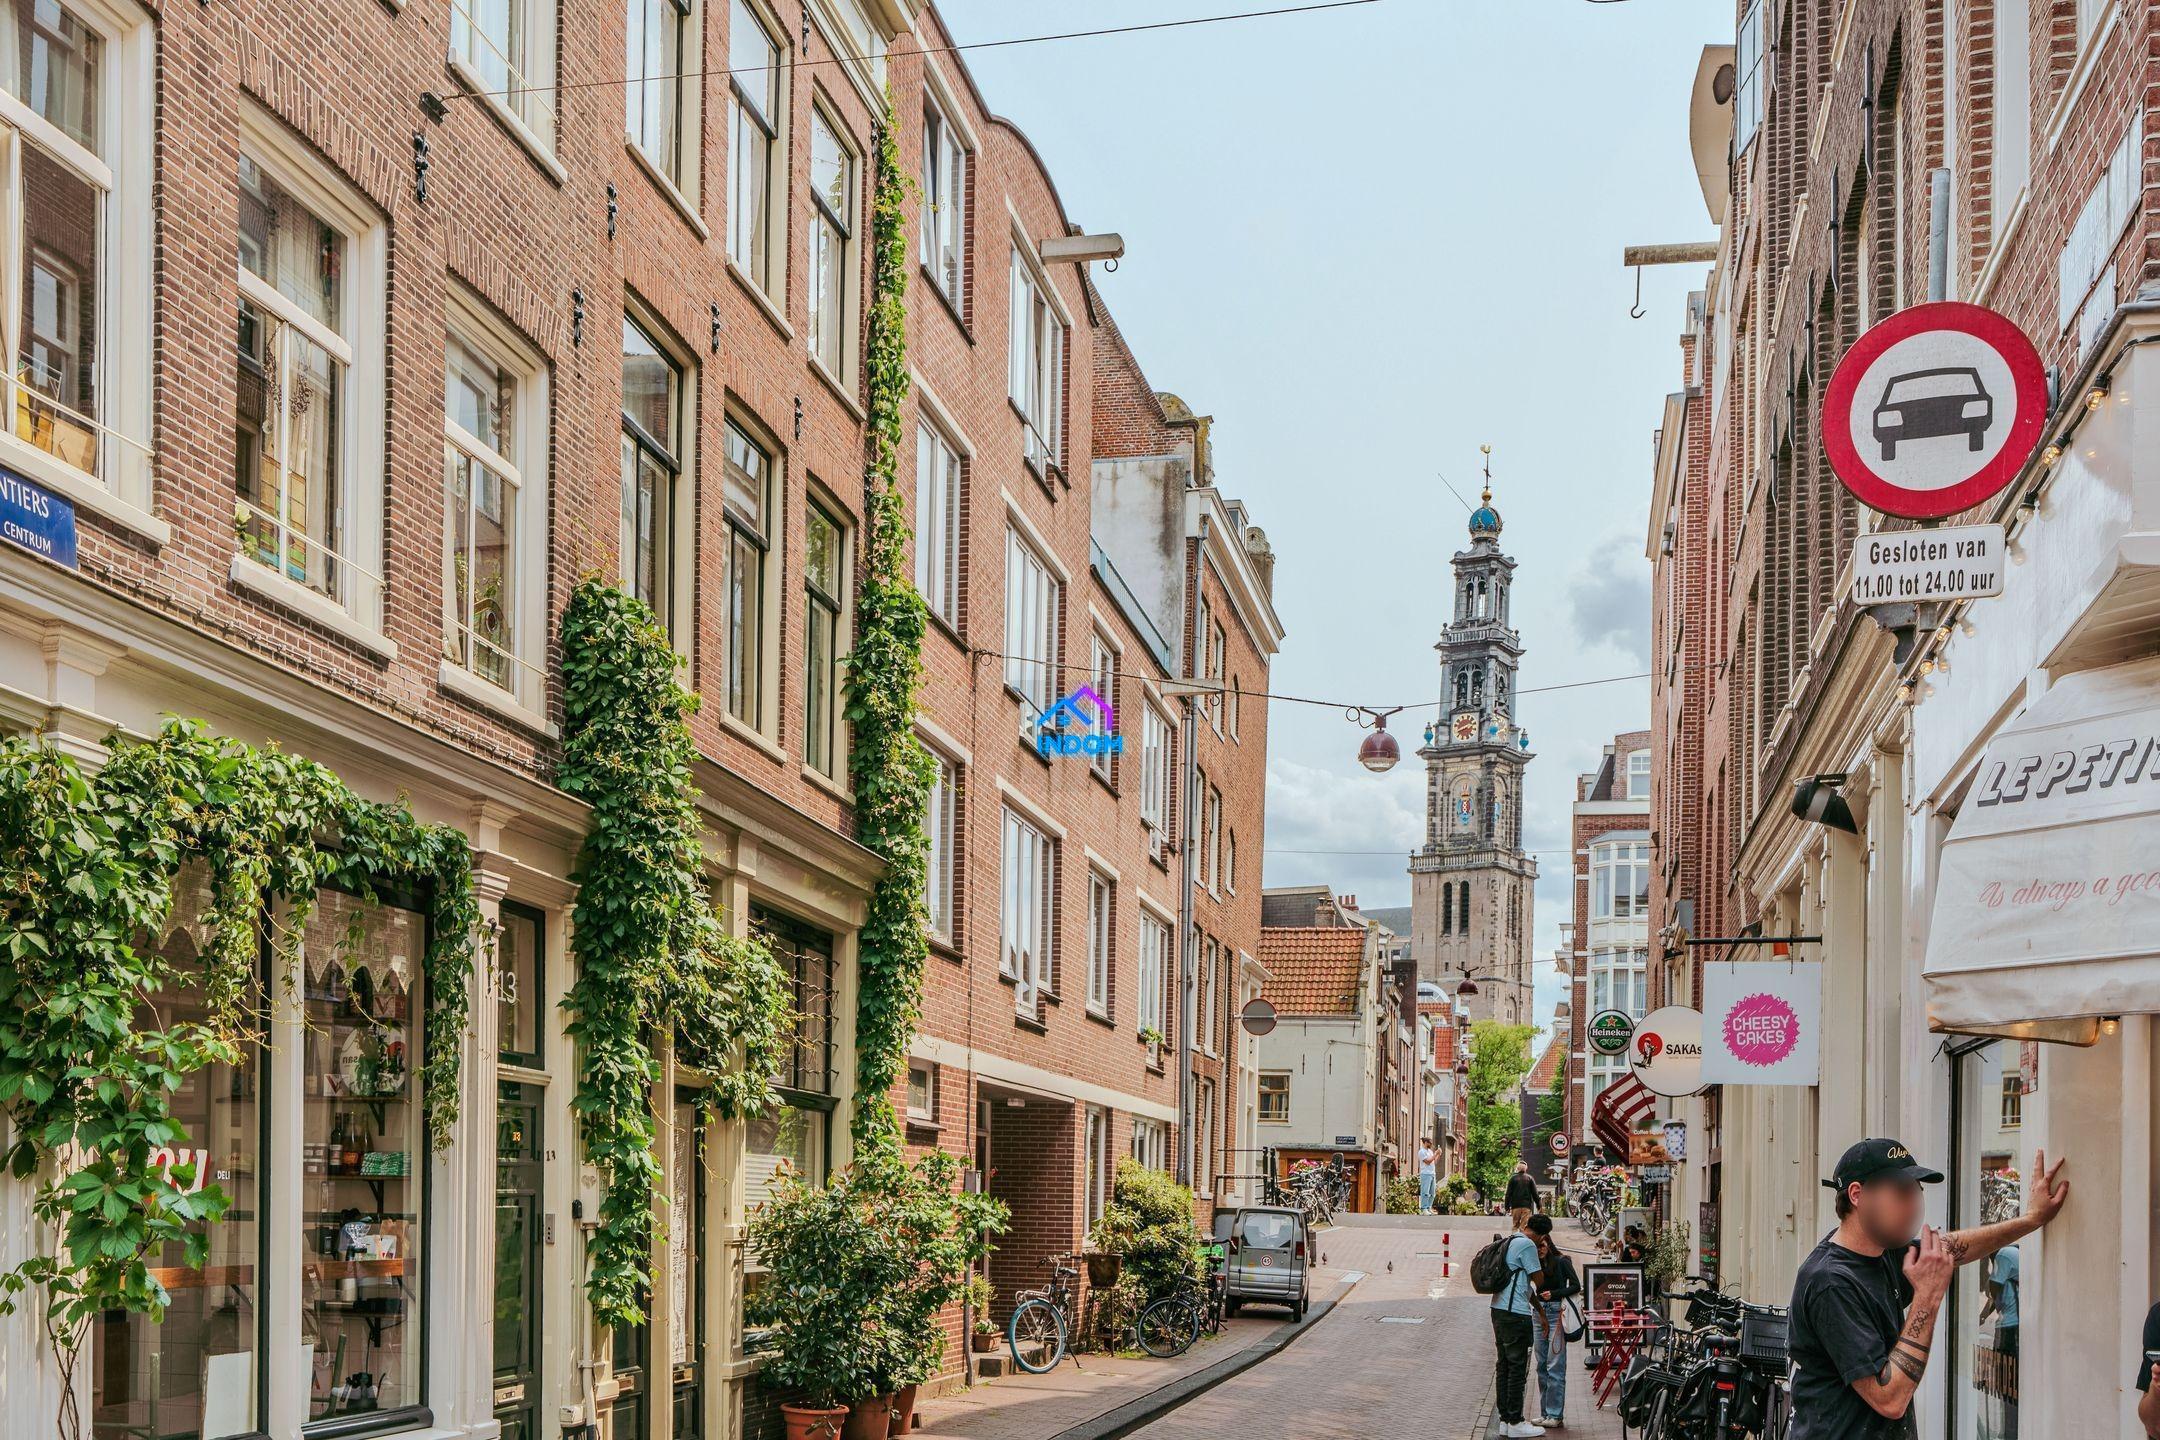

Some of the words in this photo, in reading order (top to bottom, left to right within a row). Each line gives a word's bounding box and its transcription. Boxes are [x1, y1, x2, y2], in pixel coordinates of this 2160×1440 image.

[4, 520, 51, 555] CENTRUM
[1870, 539, 1948, 565] Gesloten
[1956, 539, 1986, 559] van
[1855, 574, 1893, 599] 11.00
[1900, 572, 1920, 596] tot
[1925, 569, 1964, 594] 24.00
[1971, 571, 1995, 591] uur
[1977, 755, 2043, 808] LE
[2012, 878, 2087, 912] always
[2093, 876, 2110, 896] a
[2109, 871, 2160, 907] goo
[1592, 1028, 1632, 1037] Heineken
[1733, 1014, 1790, 1032] CHEESY
[1736, 1030, 1786, 1046] CAKES
